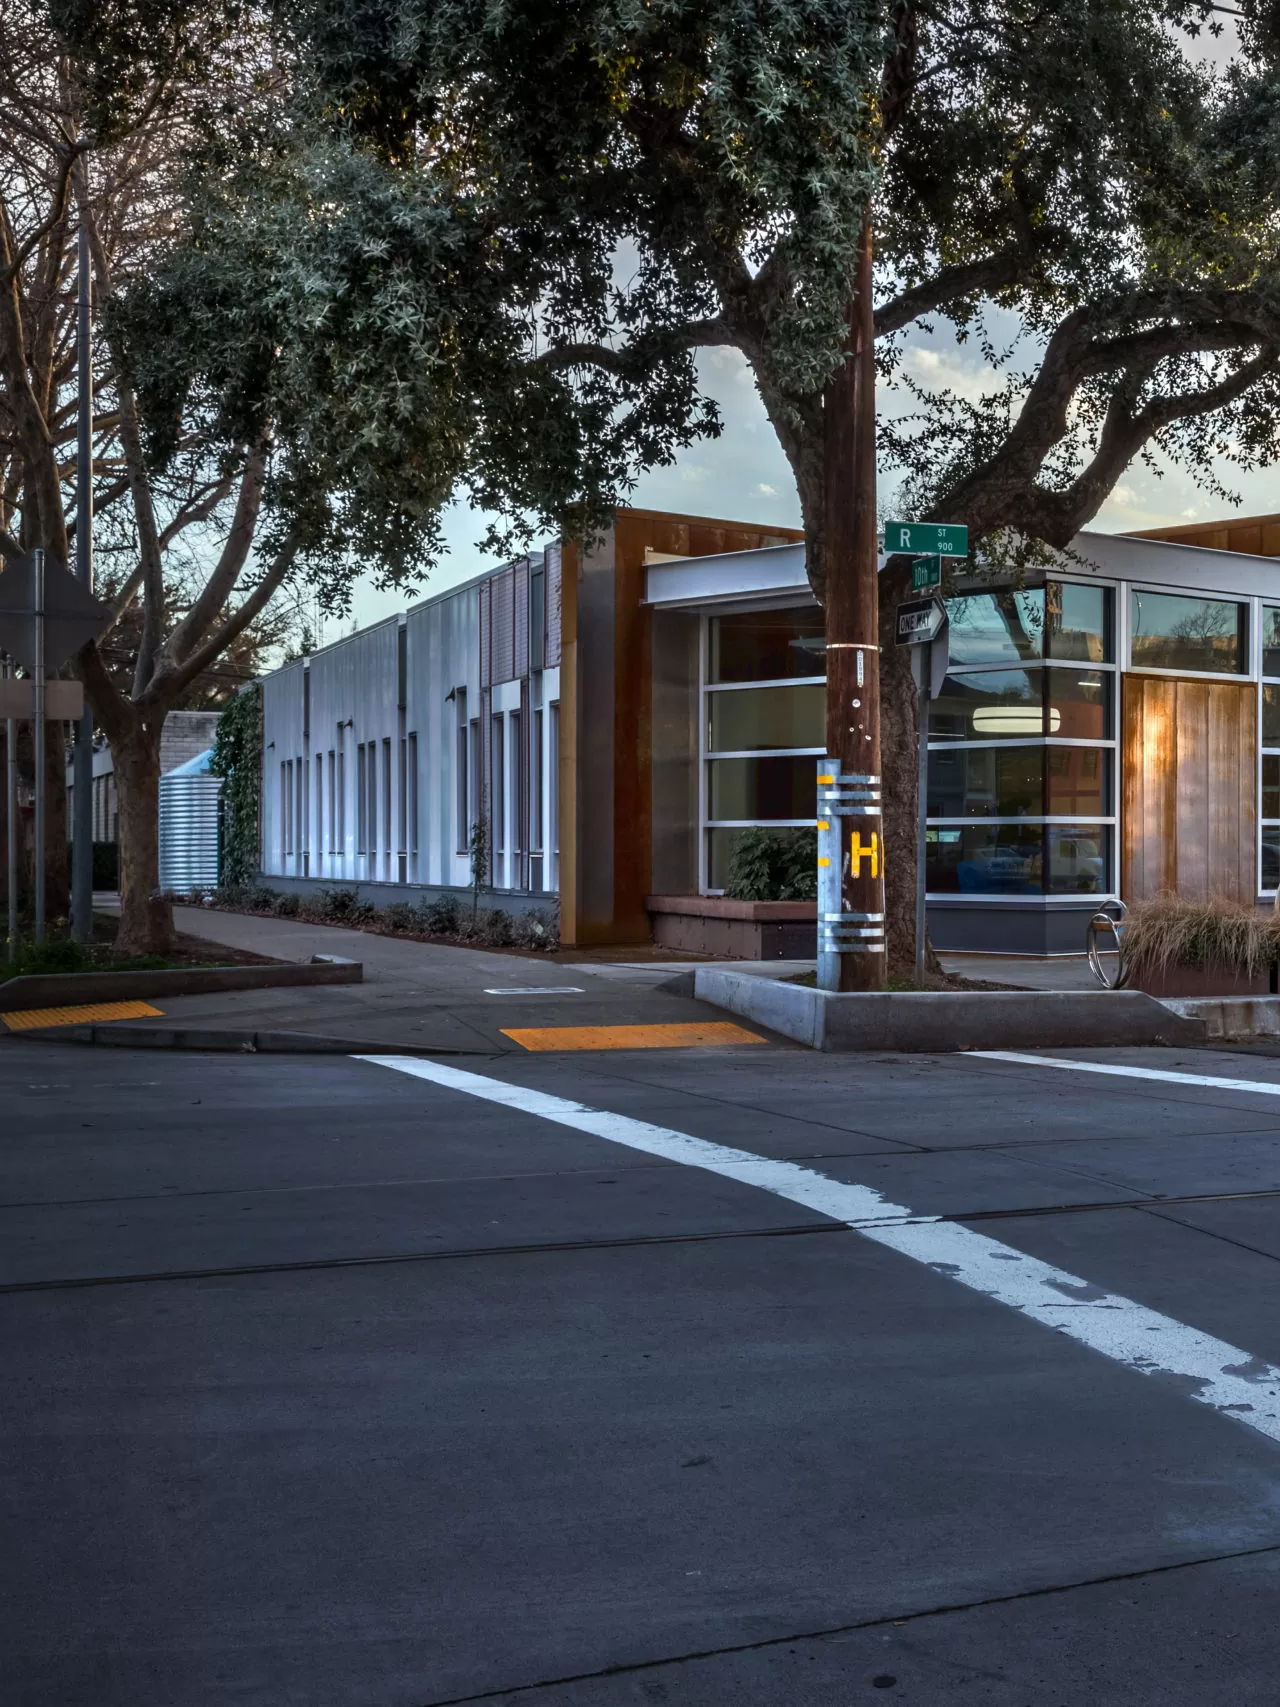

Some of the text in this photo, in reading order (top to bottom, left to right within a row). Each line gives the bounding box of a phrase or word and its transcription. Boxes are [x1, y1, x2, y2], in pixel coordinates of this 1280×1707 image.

[900, 528, 947, 548] R ST
[937, 542, 953, 551] 900
[914, 565, 928, 587] 10th
[900, 610, 930, 632] ONE WAY
